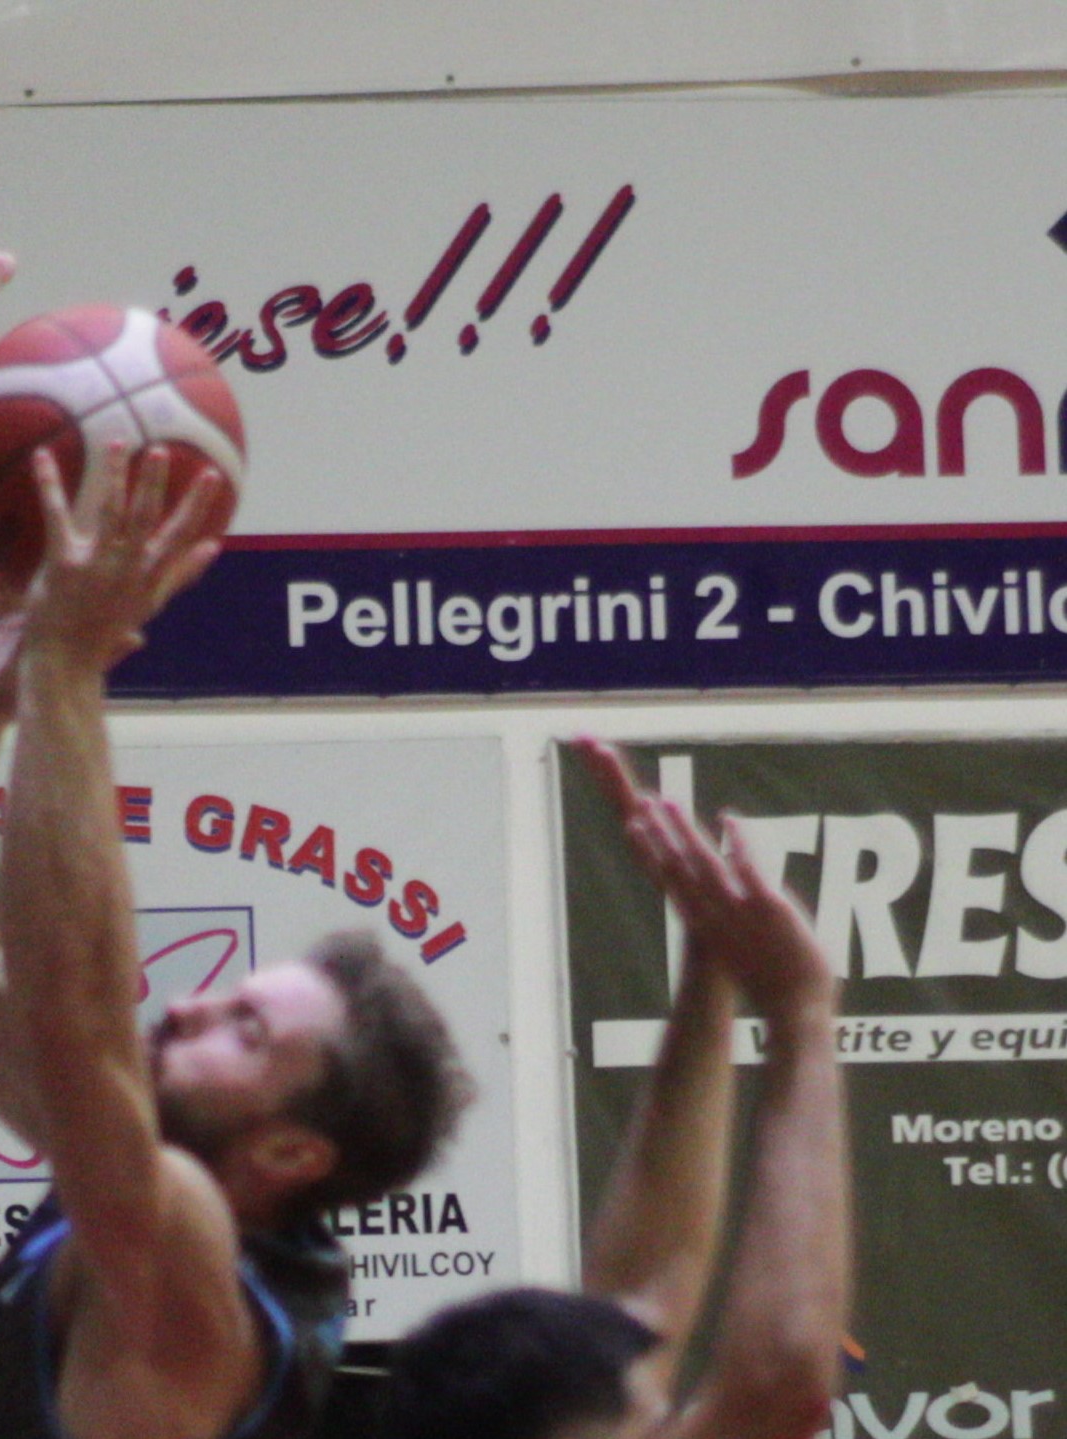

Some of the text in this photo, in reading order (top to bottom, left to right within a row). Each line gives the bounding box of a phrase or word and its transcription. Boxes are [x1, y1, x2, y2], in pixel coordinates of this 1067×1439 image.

[732, 367, 1067, 479] san
[286, 578, 666, 662] Pellegrini
[694, 576, 739, 639] 2
[114, 785, 153, 844] E
[185, 794, 468, 966] GRASSI
[927, 1027, 956, 1060] y
[891, 1113, 1063, 1144] Moreno
[942, 1153, 1034, 1187] Tel.:
[333, 1192, 469, 1237] LERIA
[349, 1251, 495, 1279] HIVILCOY
